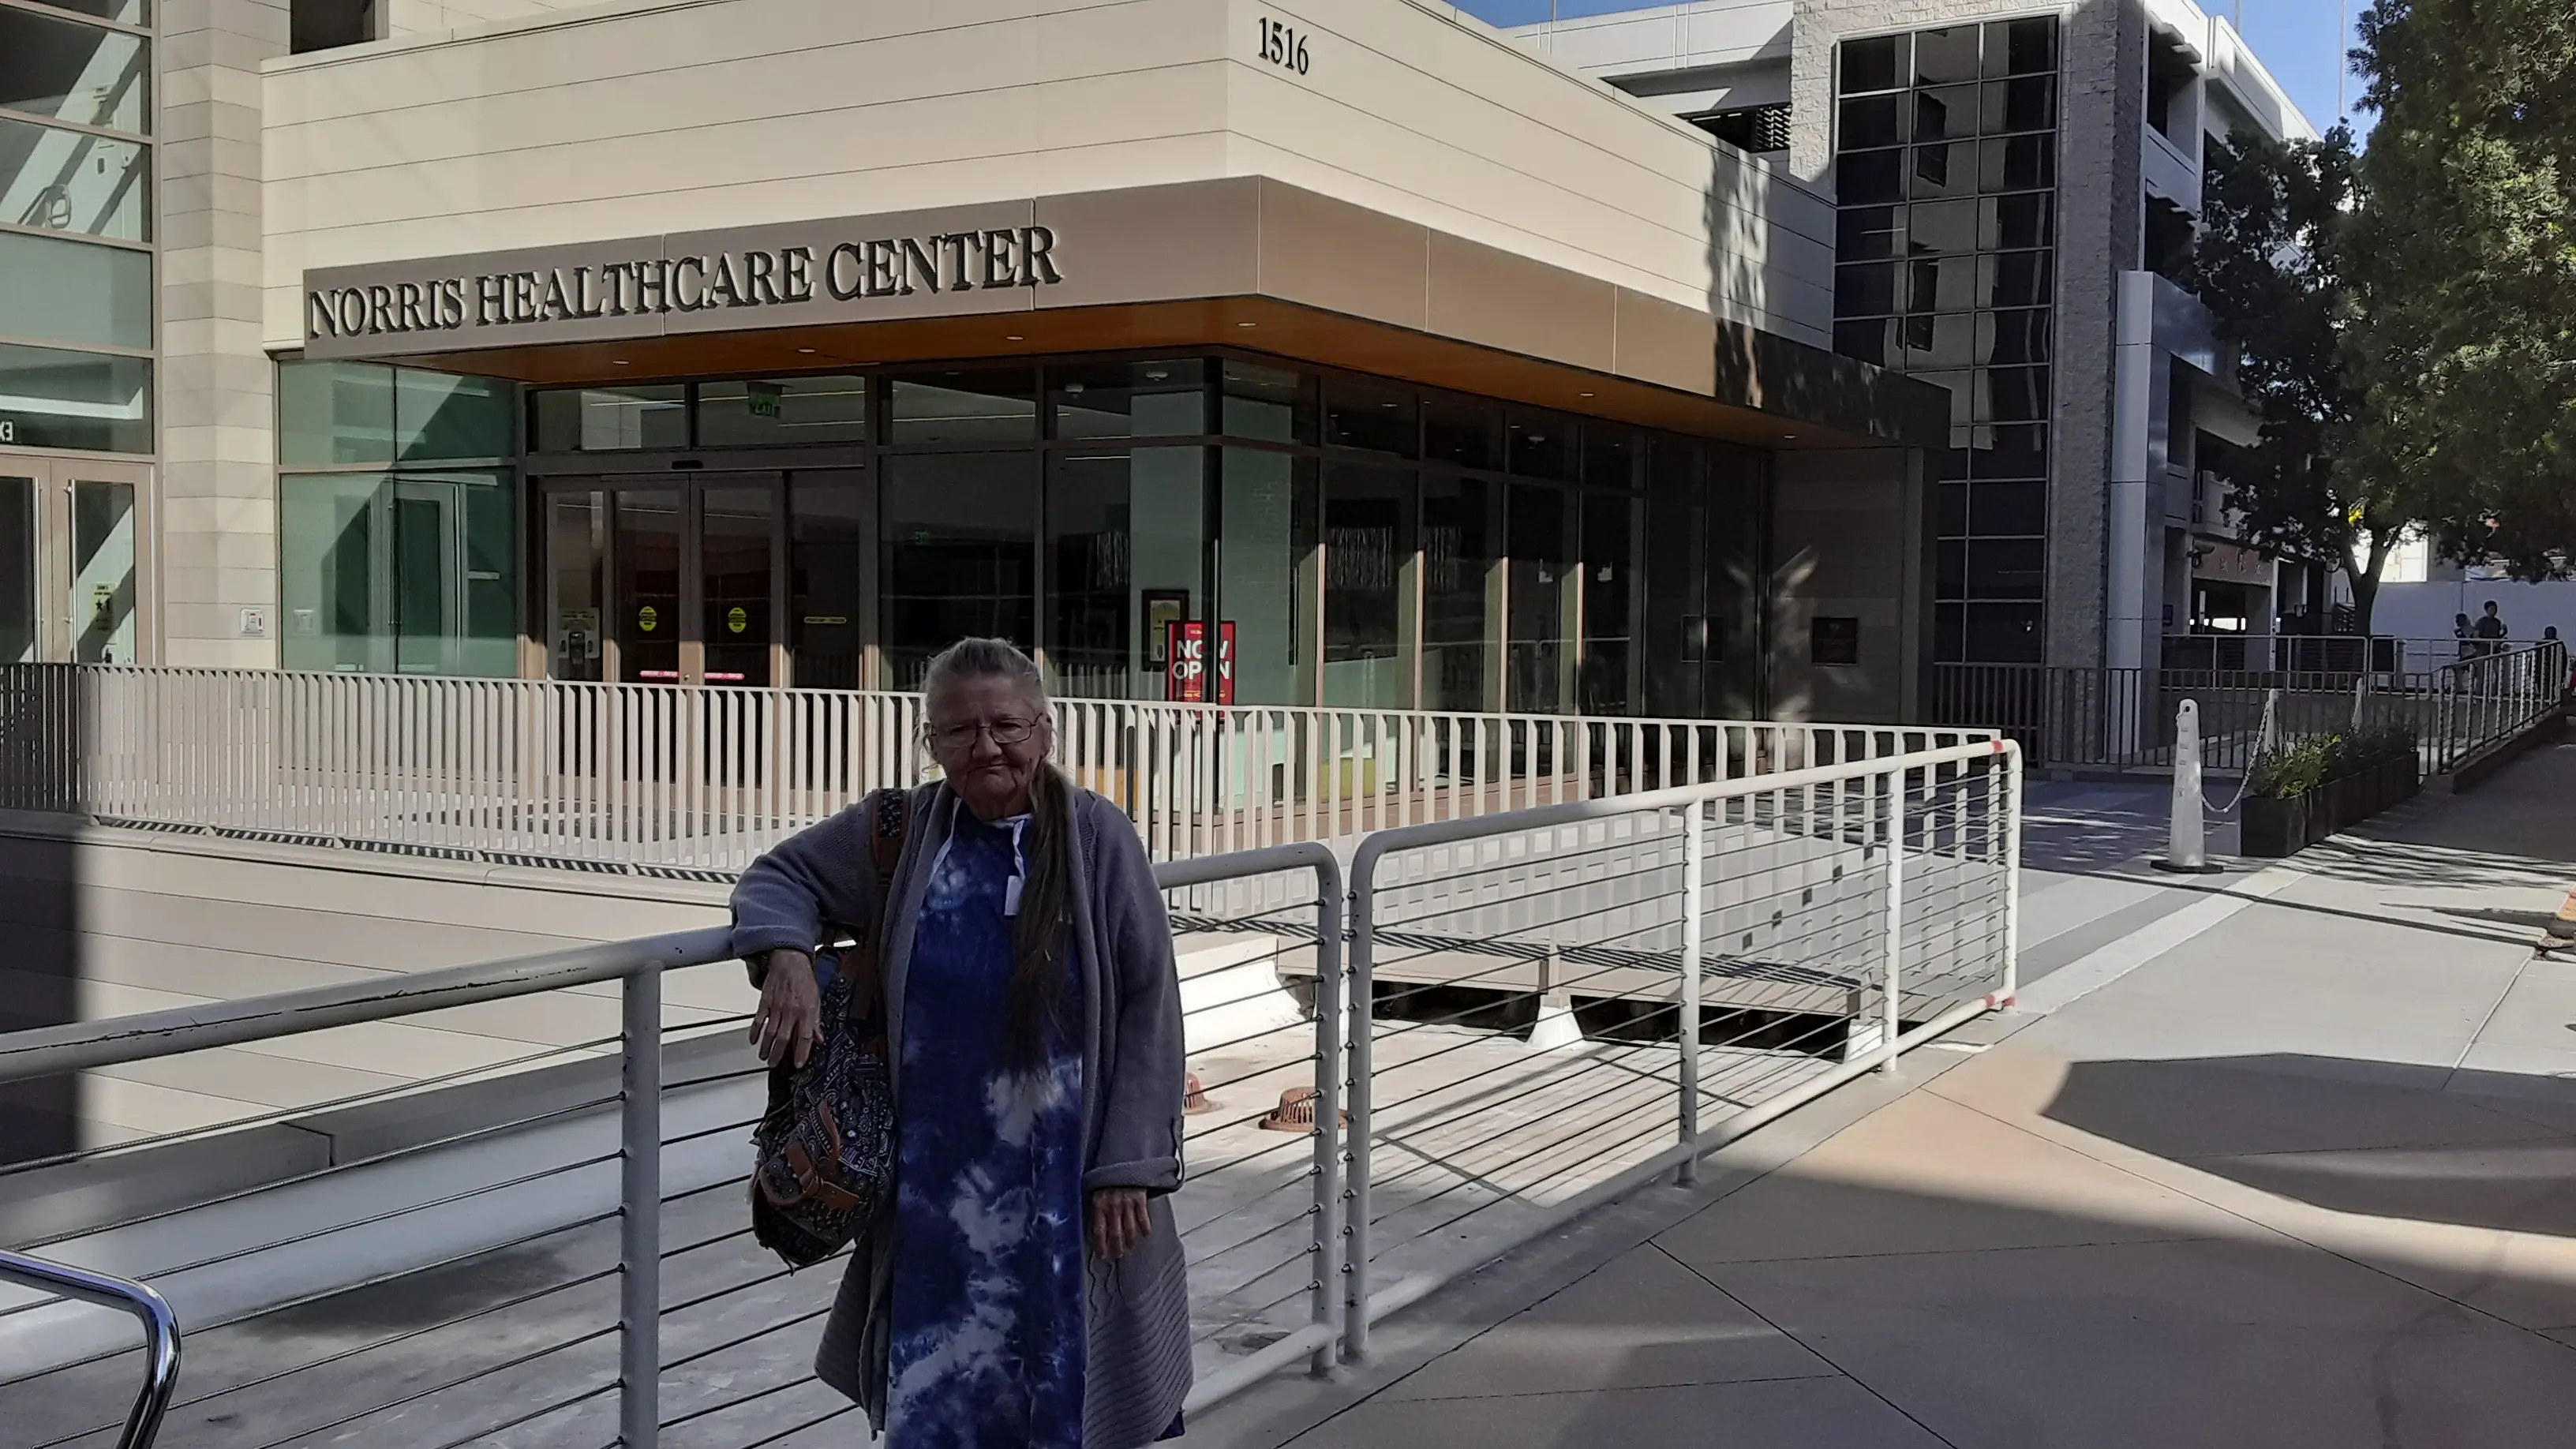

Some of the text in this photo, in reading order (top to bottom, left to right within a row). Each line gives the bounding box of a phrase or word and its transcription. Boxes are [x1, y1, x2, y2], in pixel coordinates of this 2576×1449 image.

[1258, 17, 1309, 76] 1516
[309, 223, 1065, 340] NORRIS HEALTHCARE CENTER
[1172, 661, 1230, 680] OPN
